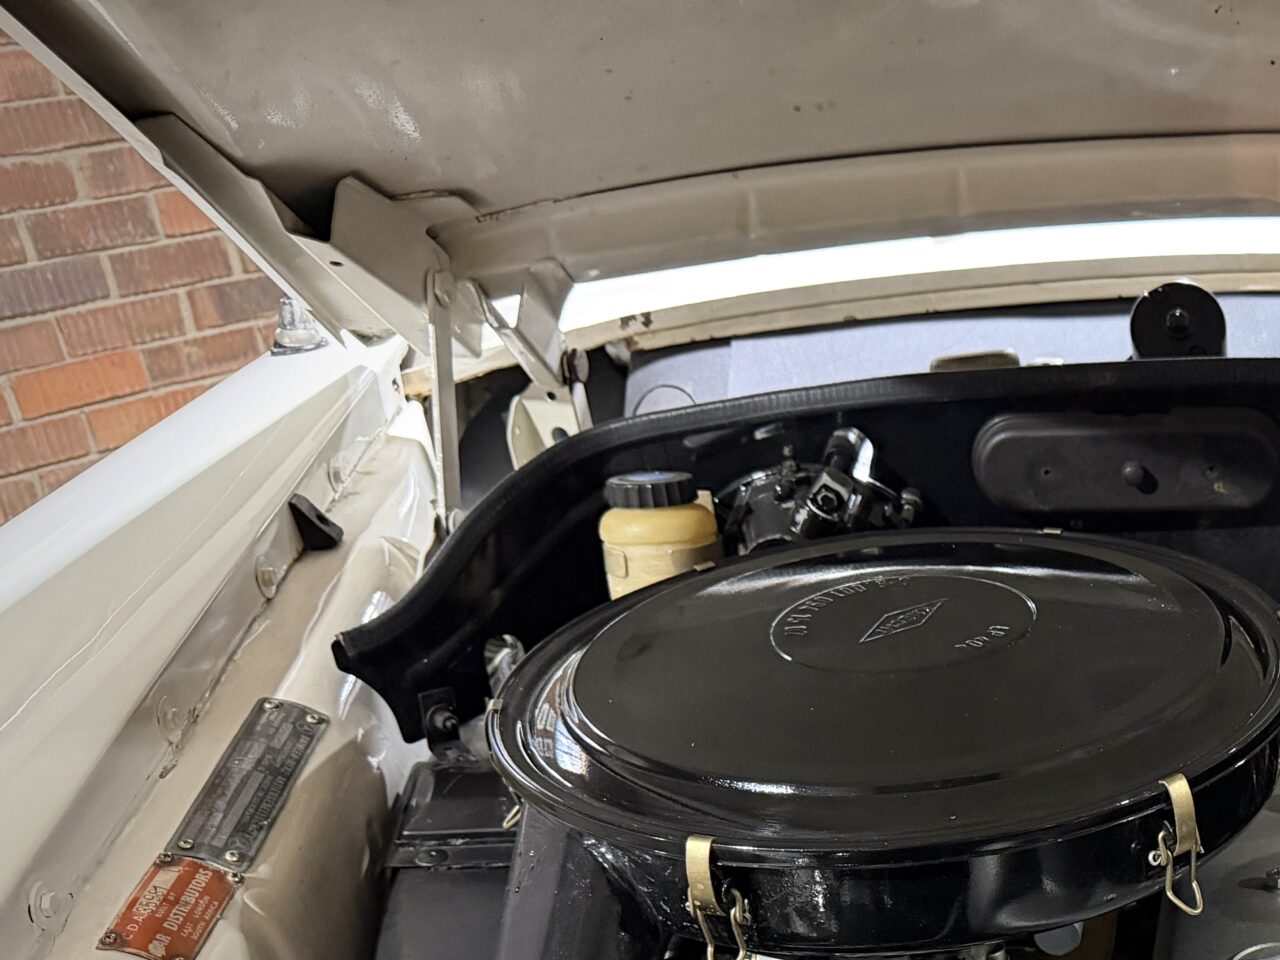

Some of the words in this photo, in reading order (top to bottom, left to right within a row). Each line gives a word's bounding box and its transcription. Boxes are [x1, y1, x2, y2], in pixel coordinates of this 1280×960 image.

[145, 931, 171, 958] AR
[168, 866, 213, 932] DISTRIBUTORS
[190, 920, 205, 940] SOUTH
